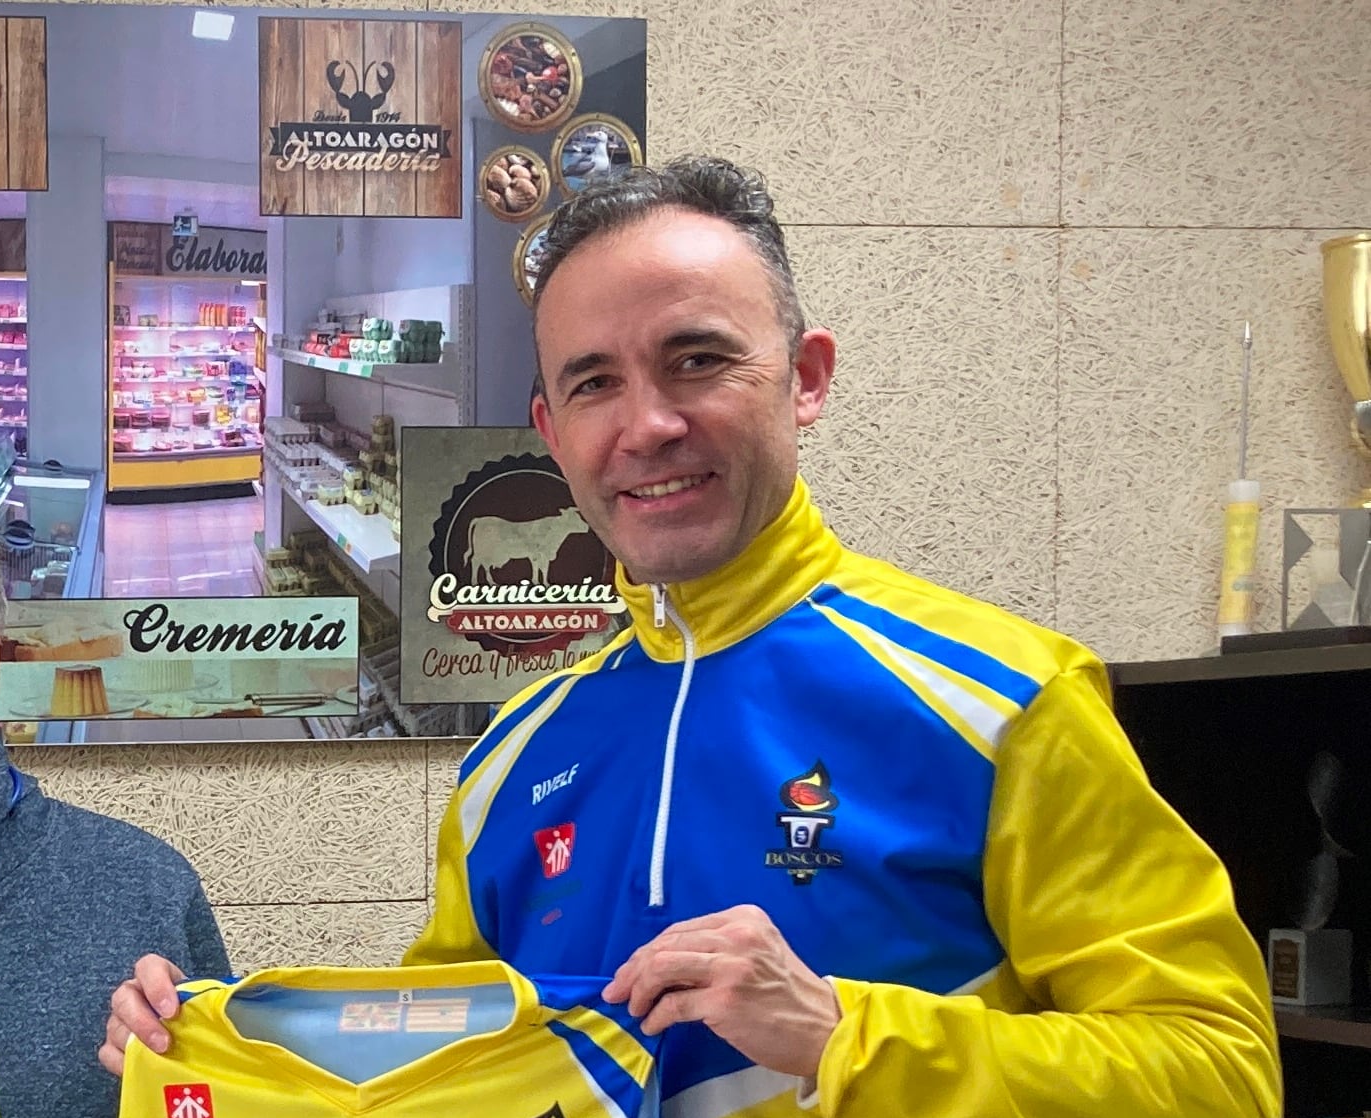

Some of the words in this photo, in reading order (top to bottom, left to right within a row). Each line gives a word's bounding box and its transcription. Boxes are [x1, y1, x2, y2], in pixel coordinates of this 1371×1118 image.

[276, 140, 442, 172] Pescadería
[166, 236, 267, 274] Elabora
[430, 573, 617, 610] Carnicería
[123, 604, 346, 653] Cremería
[458, 610, 598, 630] ALTOARAGÓN
[423, 648, 484, 677] Cerca
[488, 652, 500, 679] y
[532, 763, 580, 806] RIVELF
